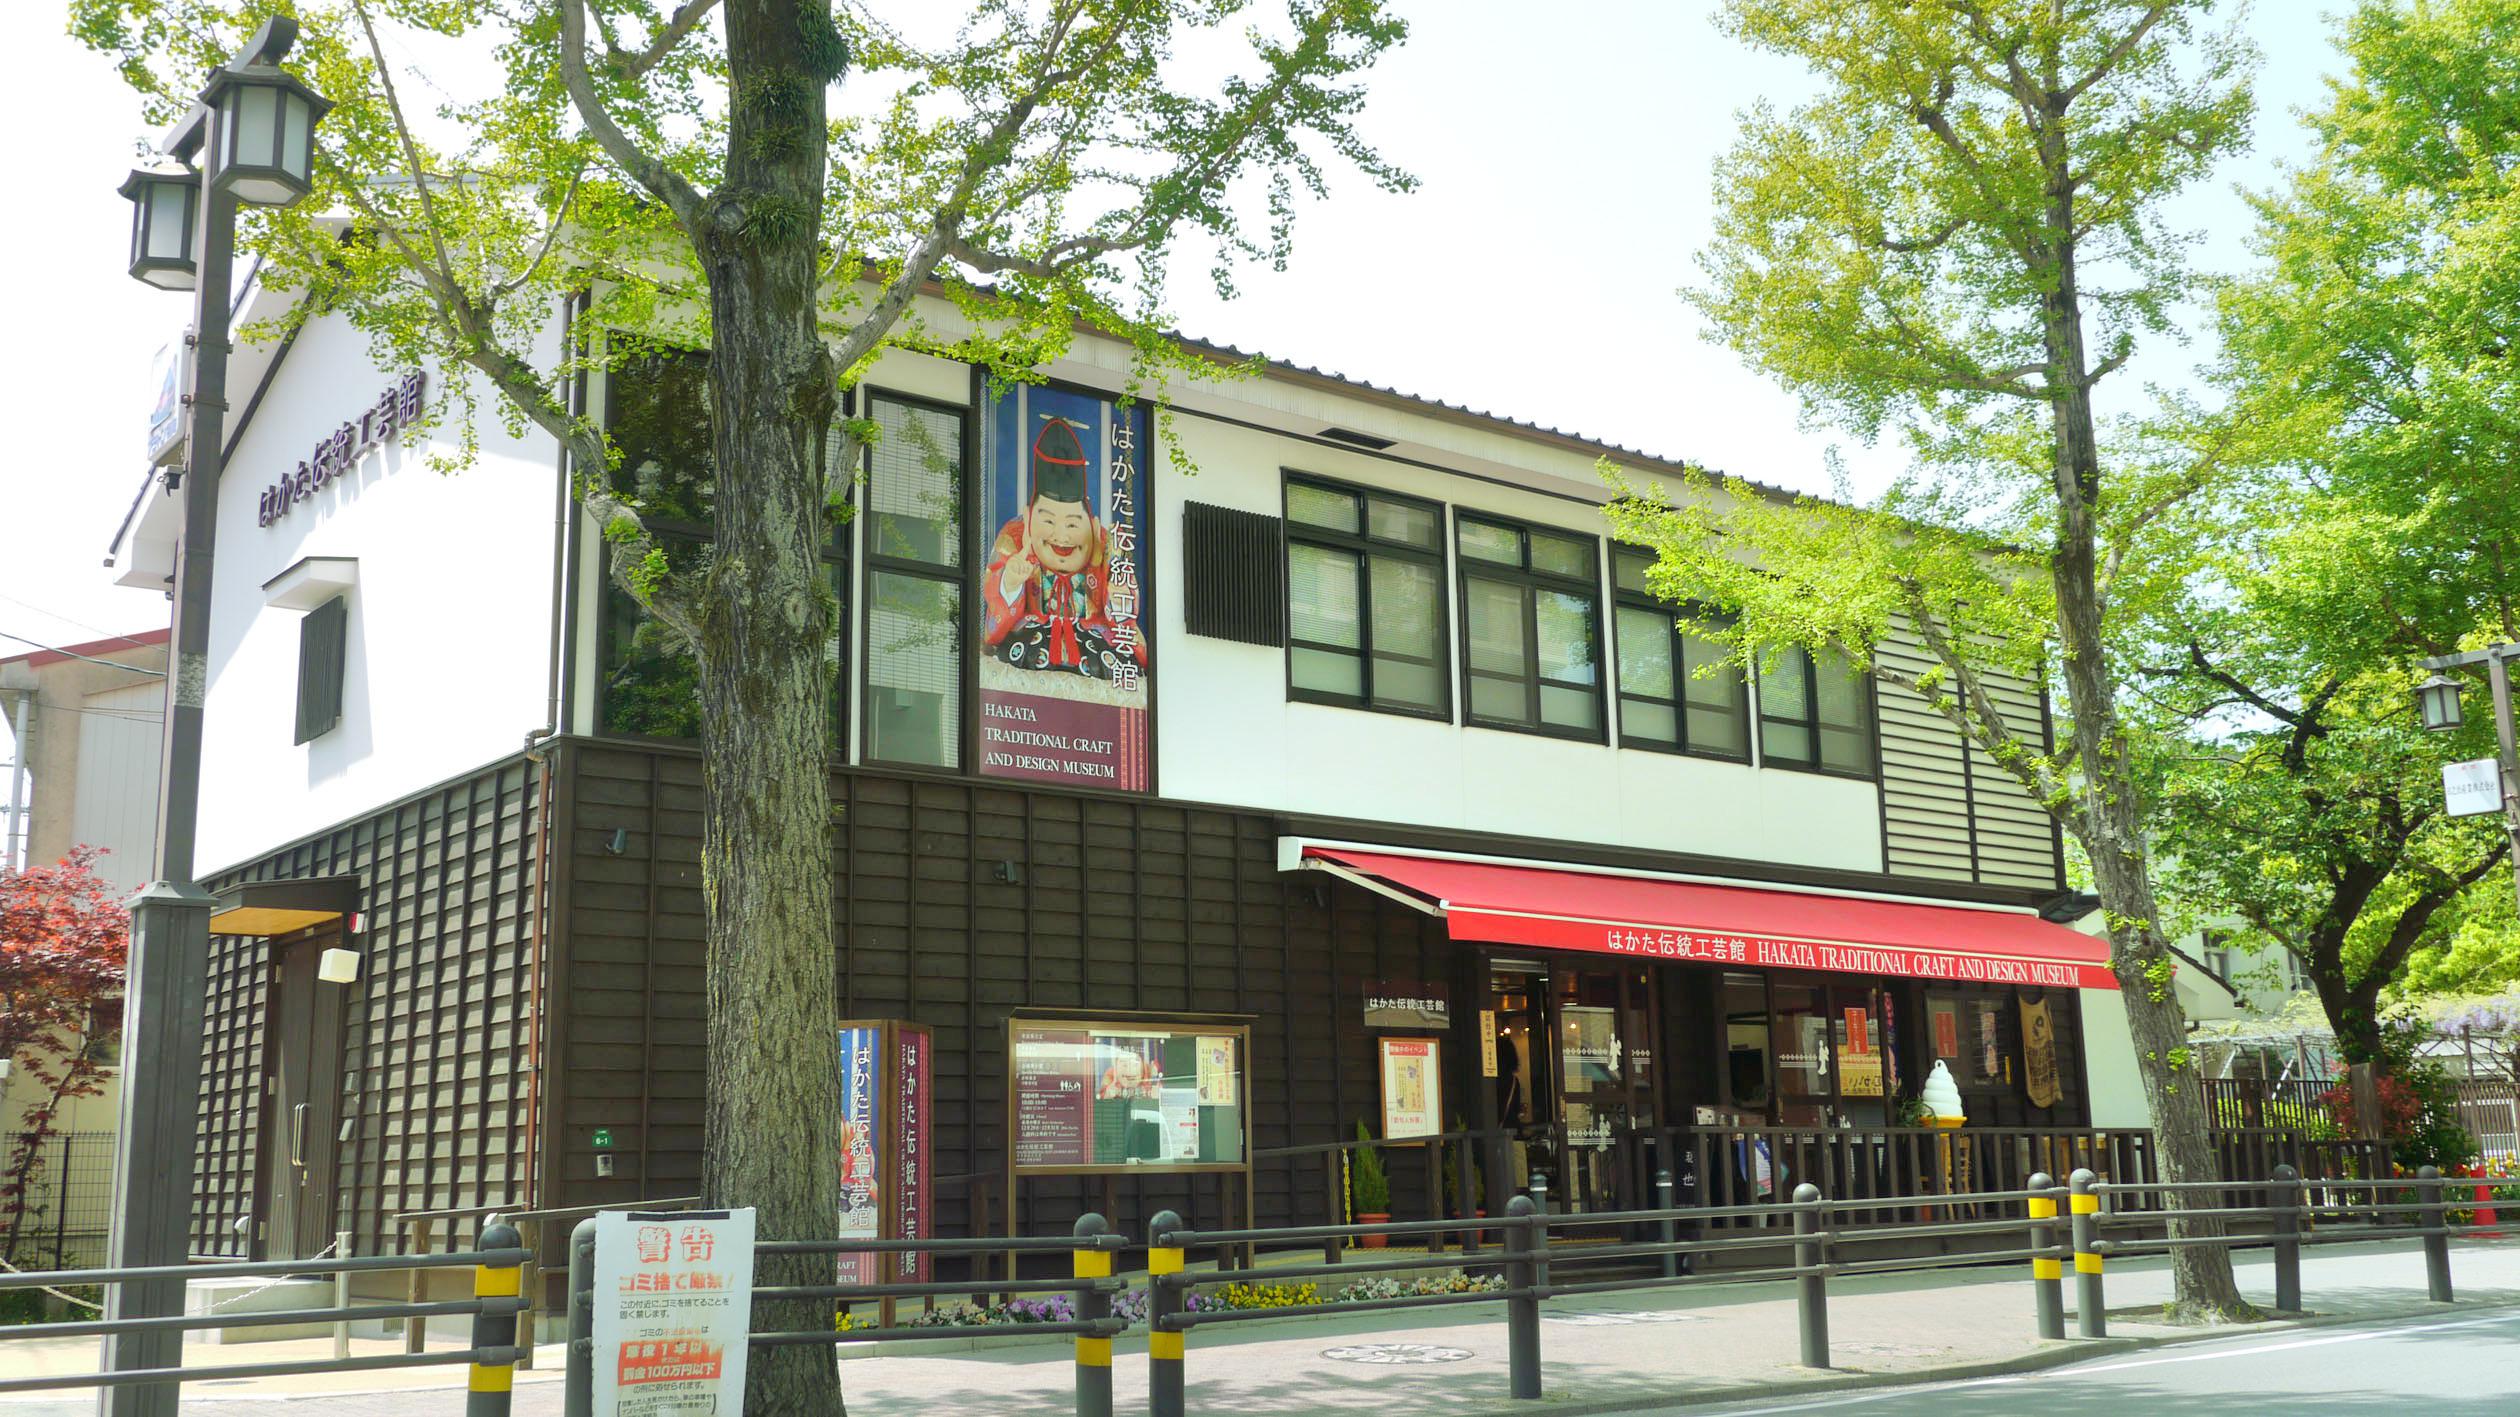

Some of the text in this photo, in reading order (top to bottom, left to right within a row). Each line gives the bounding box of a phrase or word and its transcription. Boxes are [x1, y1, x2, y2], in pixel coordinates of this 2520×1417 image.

[259, 370, 427, 528] はかた伝統工芸館
[1110, 423, 1139, 692] はかた伝統工芸館
[985, 703, 1037, 722] HAKATA
[984, 727, 1113, 755] TRADITIONAL CRAFT
[985, 751, 1115, 779] AND DESIGN MUSEUM
[1607, 930, 2080, 986] はかた伝統工芸館 HAKATA TRADITIONAL CRAFT AND DESIGN MUSEUM
[1369, 998, 1445, 1011] はかた伝統工芸館
[849, 1046, 871, 1227] はかた伝統工芸館
[906, 1044, 916, 1274] はかた伝統工芸館
[638, 1225, 715, 1264] 警告
